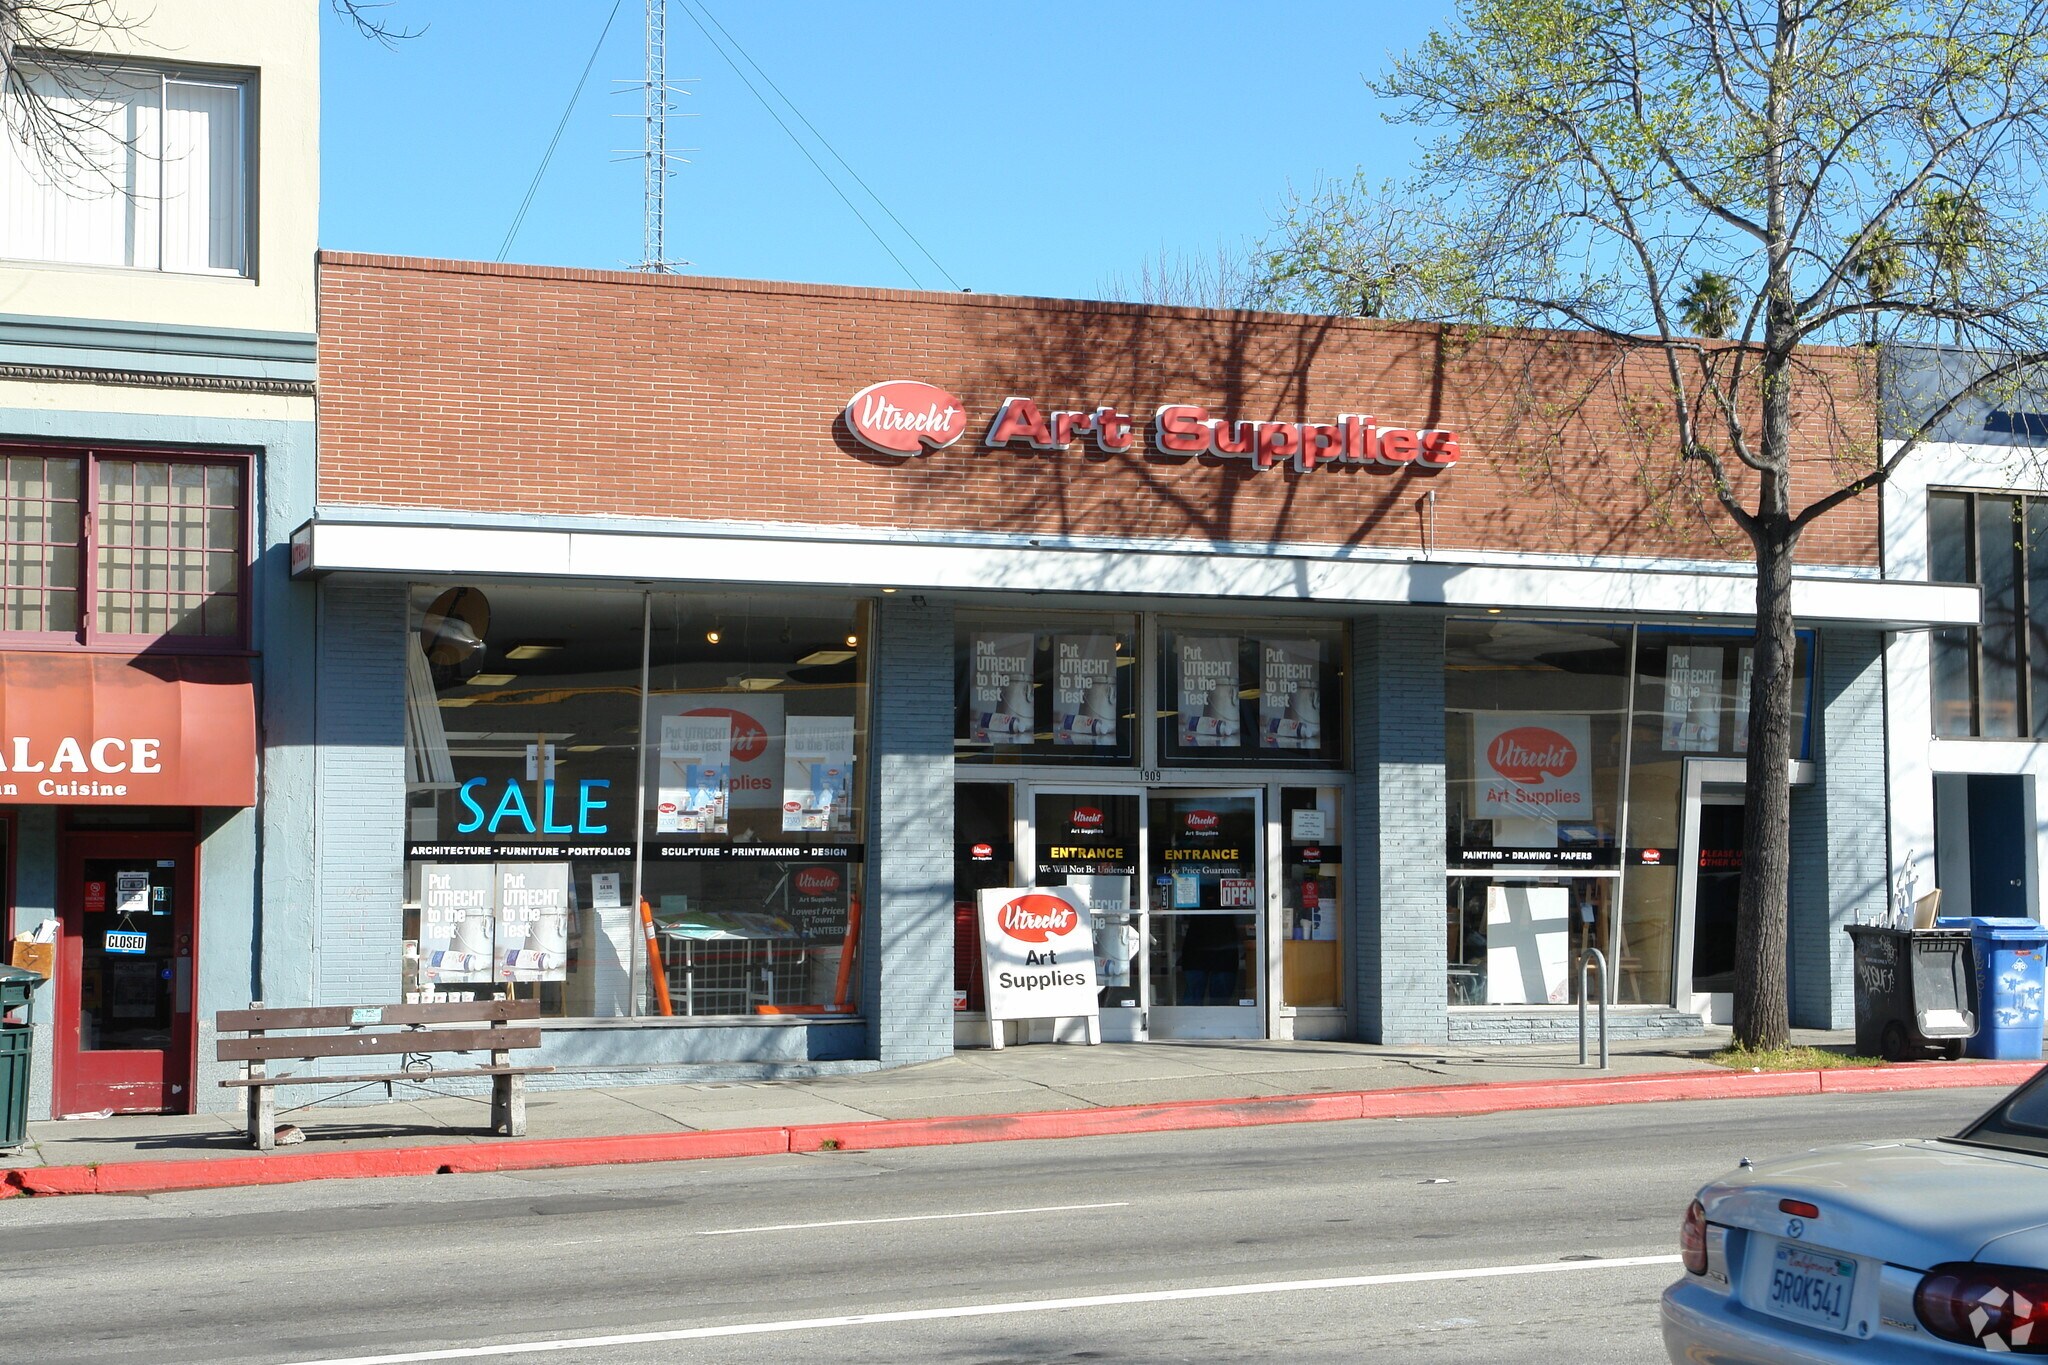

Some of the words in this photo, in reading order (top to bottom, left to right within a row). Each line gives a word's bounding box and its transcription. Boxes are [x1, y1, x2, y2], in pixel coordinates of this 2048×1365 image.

[862, 395, 960, 432] Utrecht
[985, 396, 1134, 452] Art
[1156, 404, 1460, 473] Supplies
[977, 641, 996, 655] Put
[1060, 644, 1079, 658] Put
[1184, 646, 1202, 660] Put
[1266, 648, 1284, 662] Put
[977, 657, 1026, 672] UTRECHT
[1060, 660, 1109, 674] UTRECHT
[1672, 654, 1689, 668] Put
[1184, 662, 1231, 676] UTRECHT
[1266, 664, 1312, 679] UTRECHT
[976, 674, 988, 686] to
[992, 673, 1010, 686] the
[1060, 676, 1071, 688] to
[1074, 676, 1092, 688] the
[1672, 669, 1715, 684] UTRECHT
[1184, 679, 1194, 690] to
[1198, 678, 1216, 690] the
[1266, 680, 1276, 692] to
[1280, 680, 1297, 693] the
[1670, 684, 1680, 697] to
[1683, 684, 1700, 698] the
[976, 687, 1002, 701] Test
[1060, 690, 1084, 703] Test
[1184, 692, 1208, 705] Test
[1266, 693, 1289, 707] Test
[1670, 698, 1692, 712] Test
[666, 726, 683, 739] Put
[685, 726, 727, 739] UTRECHT
[808, 740, 822, 750] the
[825, 740, 845, 750] Test
[0, 737, 162, 773] LACE
[1496, 738, 1569, 770] Utrecht
[1140, 771, 1160, 780] 1909
[38, 780, 127, 796] Cuisine
[730, 773, 772, 793] plies
[1486, 789, 1509, 803] Art
[1516, 789, 1581, 804] Supplies
[458, 776, 610, 834] SALE
[1074, 811, 1102, 822] Utrecht
[1188, 814, 1216, 824] Utrecht
[411, 847, 491, 855] ARCHITECTURE
[501, 848, 559, 856] FURNITURE
[568, 847, 631, 856] PORTFOLIOS
[662, 848, 720, 856] SCULPTURE
[732, 848, 800, 856] PRINTMAKING
[1051, 848, 1123, 858] ENTRANCE
[1165, 850, 1238, 860] ENTRANCE
[1463, 851, 1502, 860] PAINTING
[1512, 851, 1551, 860] DRAWING
[1561, 852, 1592, 860] PAPERS
[1701, 849, 1734, 857] PLEASE
[1039, 865, 1051, 873] We
[1053, 865, 1068, 873] Will
[1070, 865, 1084, 874] Not
[1086, 865, 1096, 874] Be
[1098, 865, 1135, 874] Undersold
[1182, 866, 1200, 874] Price
[1202, 866, 1240, 874] Guarantee
[428, 873, 451, 889] Put
[503, 873, 525, 889] Put
[800, 874, 838, 888] Utrecht
[428, 890, 486, 906] UTRECHT
[503, 889, 560, 906] UTRECHT
[1223, 887, 1254, 905] OPEN
[427, 908, 440, 922] to
[444, 906, 466, 922] the
[502, 907, 515, 922] to
[519, 906, 541, 922] the
[792, 907, 820, 916] Lowest
[822, 907, 845, 915] Prices
[1004, 904, 1074, 929] Utrecht
[811, 916, 836, 924] Town!
[1092, 916, 1105, 930] he
[427, 923, 457, 939] Test
[502, 922, 531, 938] Test
[108, 935, 144, 949] CLOSED
[1026, 950, 1057, 966] Art
[1000, 971, 1086, 991] Supplies
